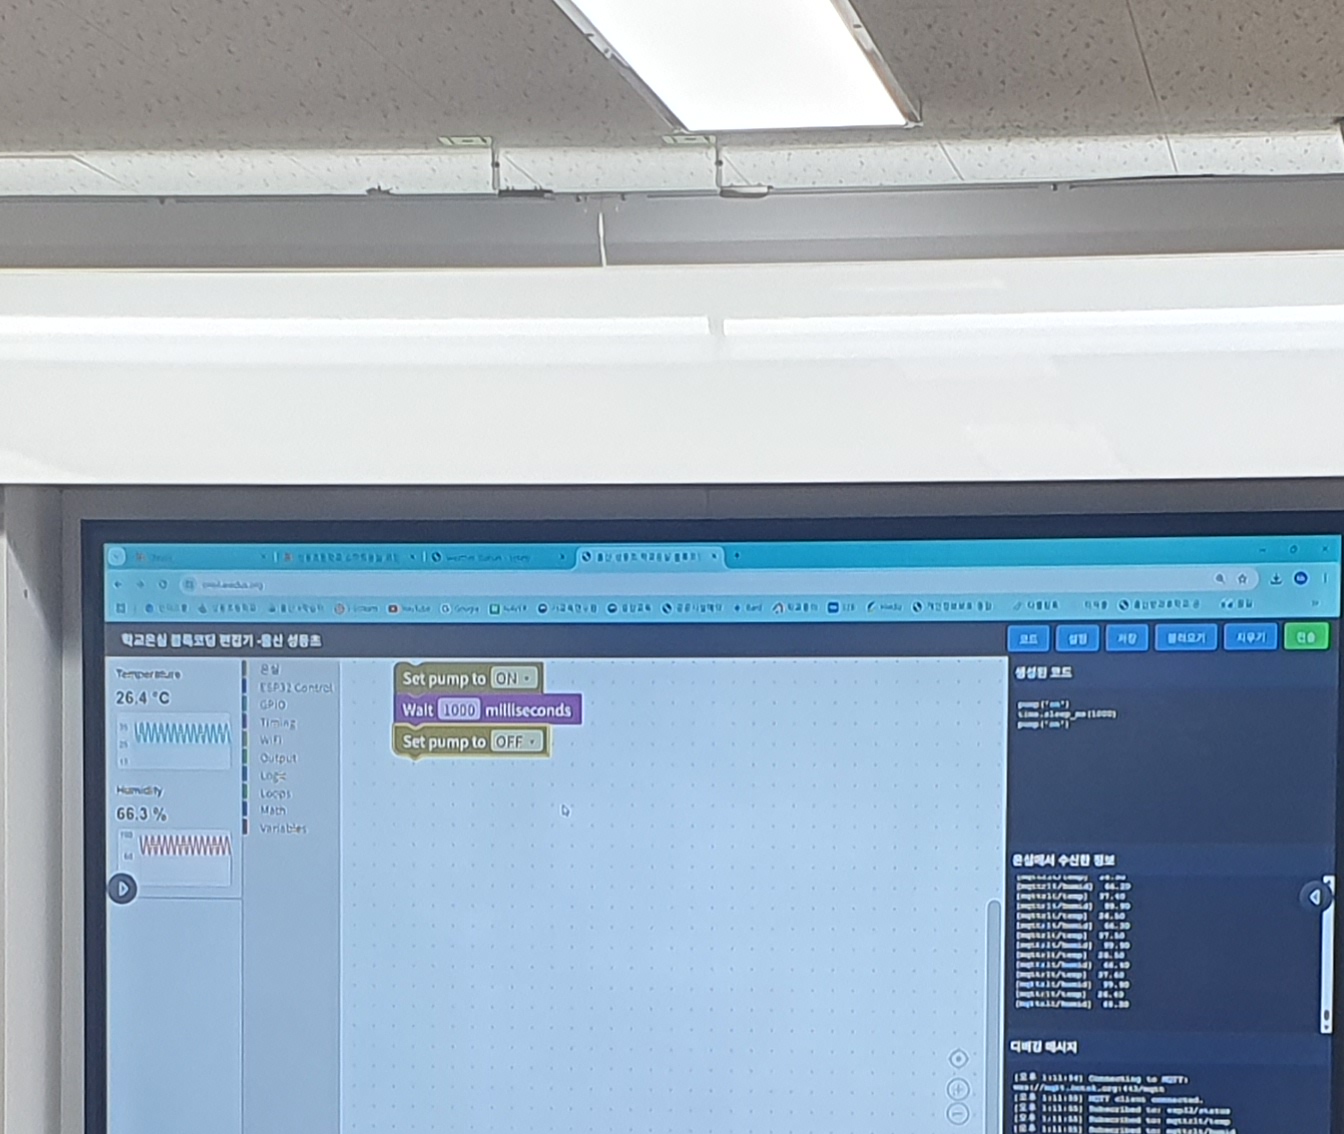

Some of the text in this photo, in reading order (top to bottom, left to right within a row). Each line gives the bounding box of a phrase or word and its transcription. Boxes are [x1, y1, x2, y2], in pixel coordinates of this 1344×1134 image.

[116, 669, 181, 680] Temperature
[403, 672, 518, 688] Set pump to ON
[294, 683, 334, 693] Control
[116, 691, 147, 704] 26.4
[260, 700, 286, 710] GPIO
[402, 703, 572, 718] Wait 1000 milliseconds
[260, 718, 296, 730] Timing
[403, 735, 523, 751] Set pump to OFF
[260, 753, 297, 765] Output
[116, 786, 163, 798] Humidity
[260, 789, 291, 800] Loops
[117, 808, 167, 822] 66.3 %
[260, 806, 286, 816] Math
[260, 824, 307, 834] Variables
